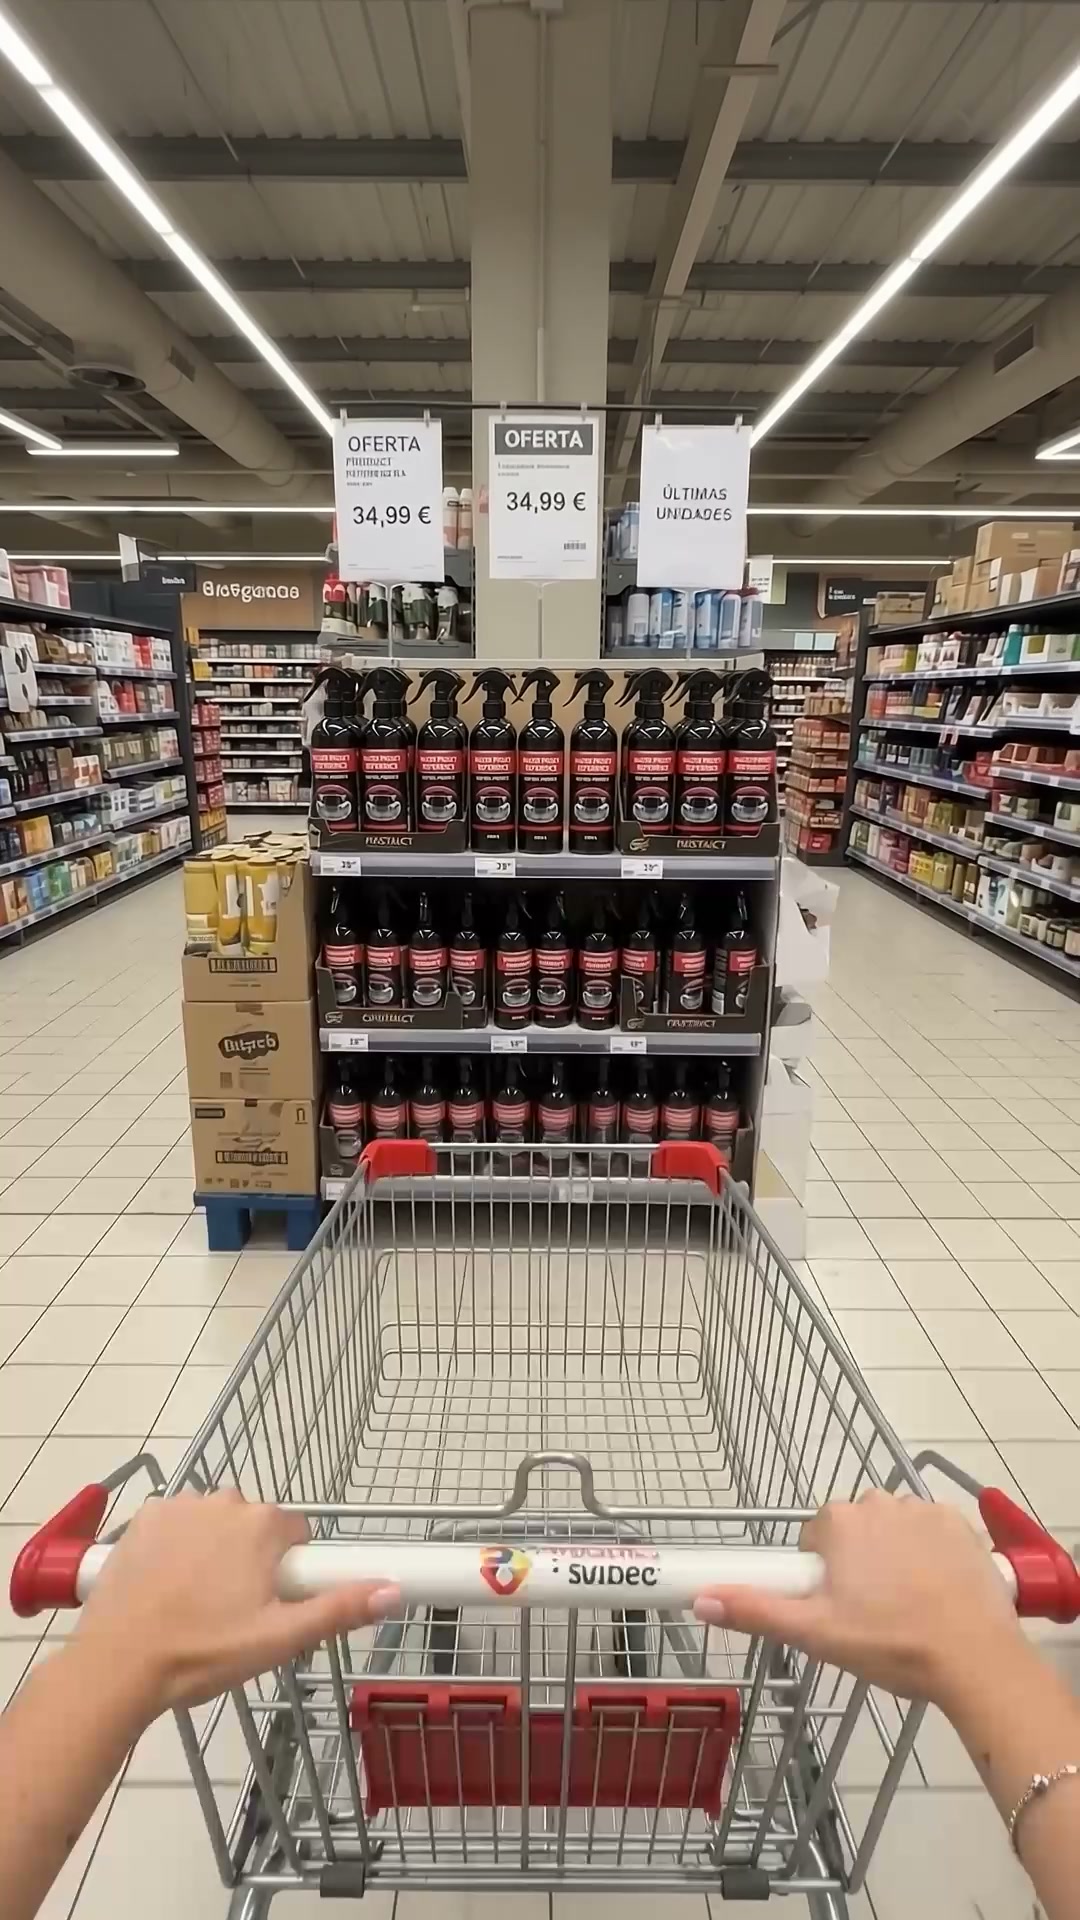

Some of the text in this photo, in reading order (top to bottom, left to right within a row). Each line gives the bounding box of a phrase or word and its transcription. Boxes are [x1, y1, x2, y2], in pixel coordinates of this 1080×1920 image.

[348, 435, 421, 452] OFERTA
[505, 429, 584, 449] OFERTA
[663, 483, 728, 501] ÚLTIMAS
[506, 491, 587, 514] 34,99 €
[353, 505, 432, 528] 34,99 €
